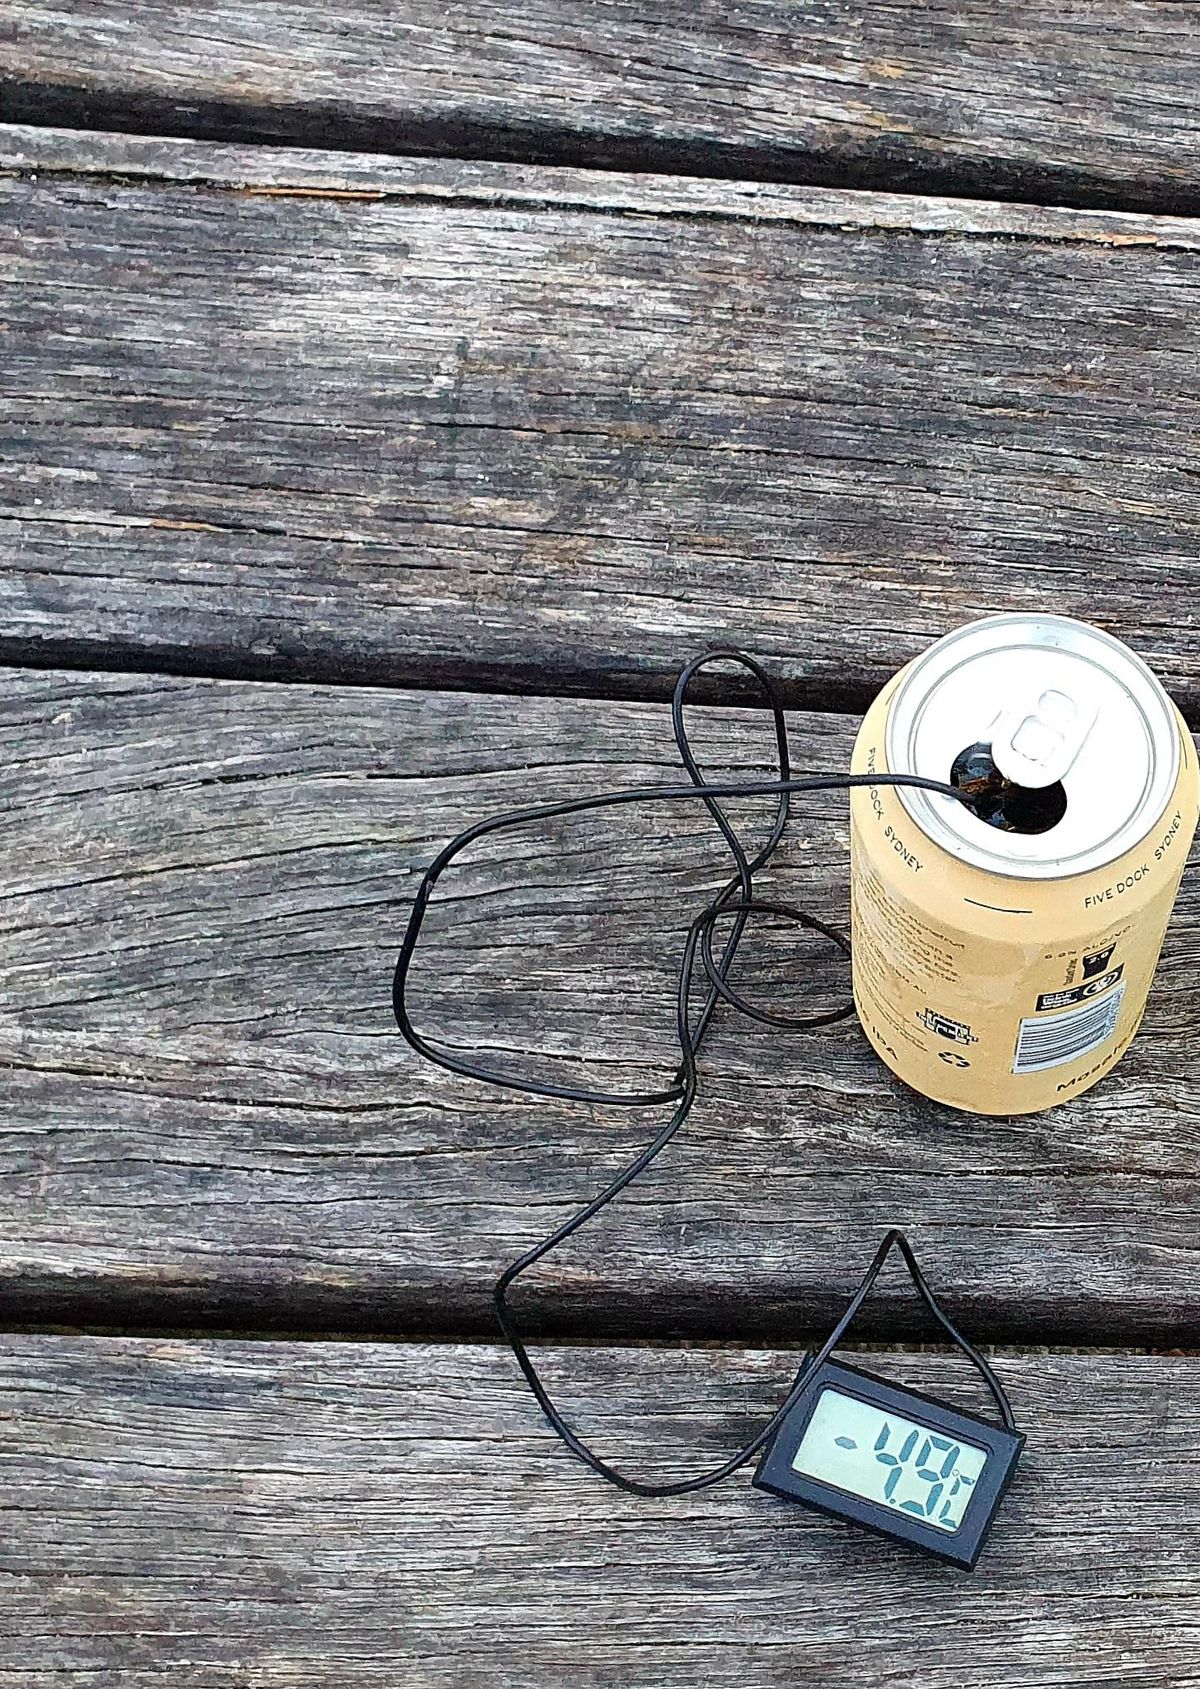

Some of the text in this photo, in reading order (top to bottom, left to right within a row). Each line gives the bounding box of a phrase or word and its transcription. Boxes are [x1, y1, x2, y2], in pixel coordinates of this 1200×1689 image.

[868, 784, 884, 821] OCK
[884, 825, 923, 873] SYDNEY
[1084, 810, 1182, 908] FIVE DOCK SYDNEY
